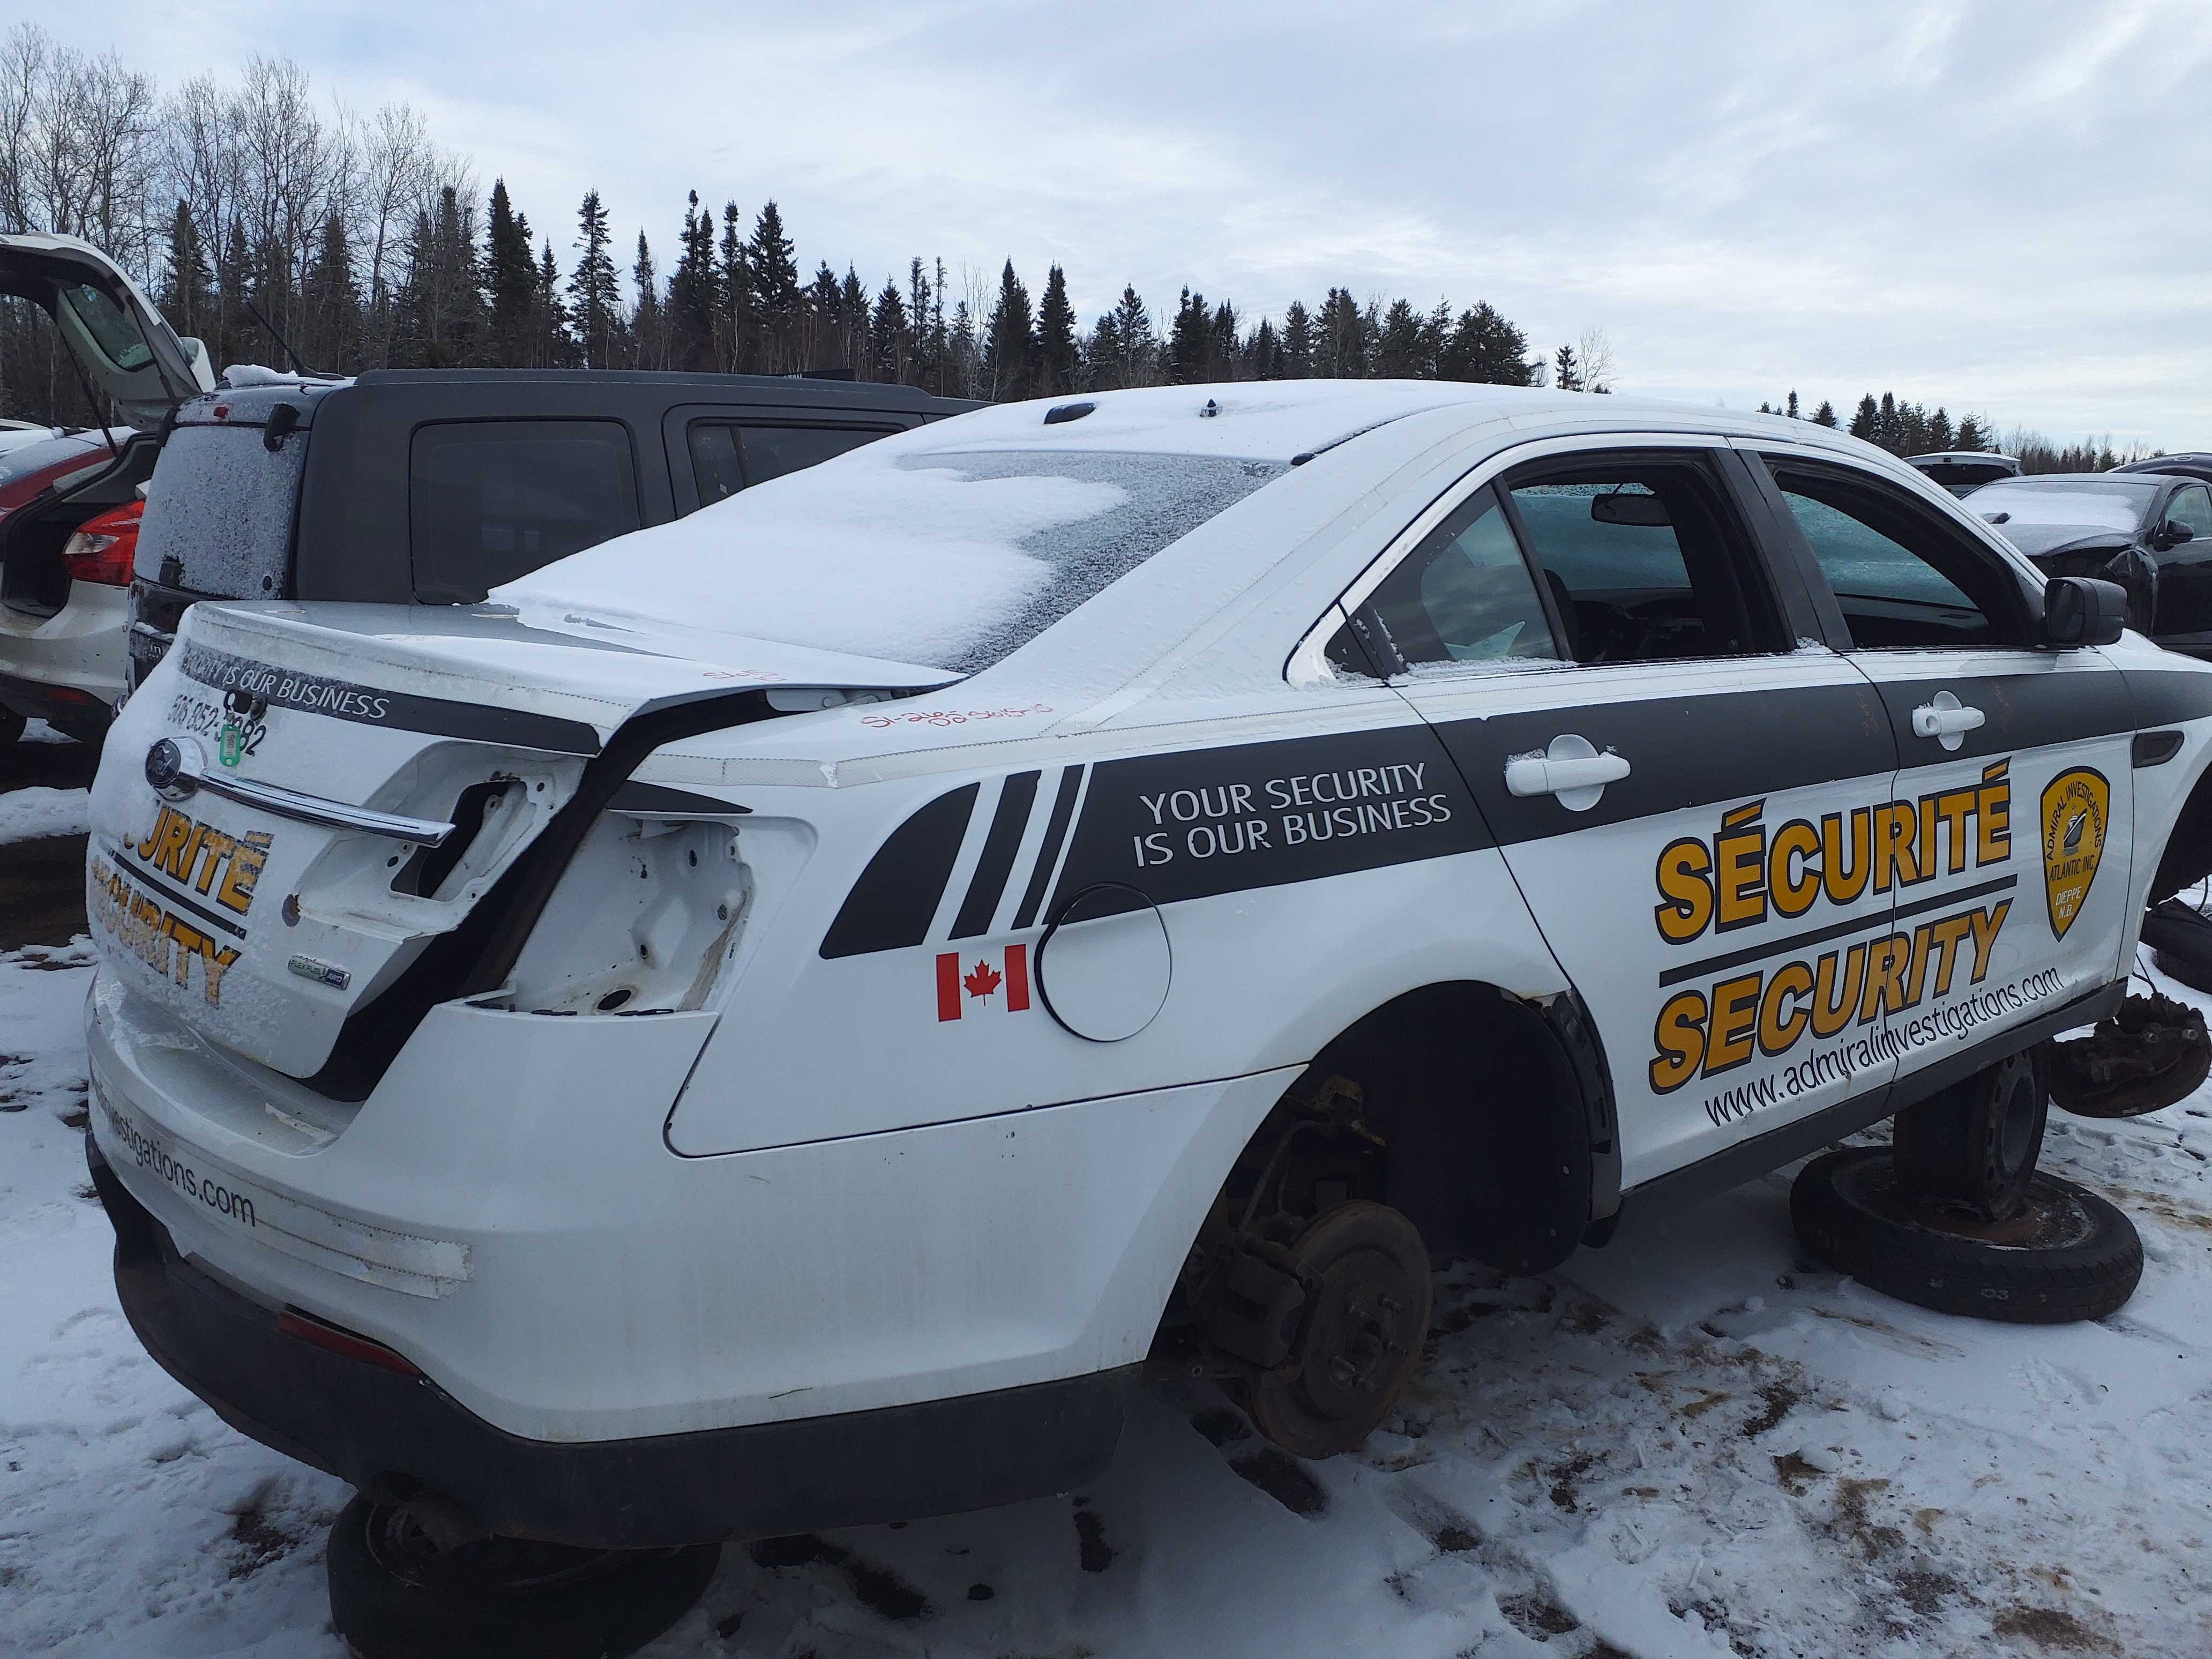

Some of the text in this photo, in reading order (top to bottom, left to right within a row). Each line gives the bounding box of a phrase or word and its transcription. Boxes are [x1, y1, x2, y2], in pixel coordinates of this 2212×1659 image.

[222, 666, 241, 685] IS
[240, 668, 276, 694] OUR
[277, 678, 390, 719] BUSINESS
[1140, 763, 1425, 825] YOUR SECURITY
[2046, 780, 2103, 861] ADMIRAL INVESTIGATIONS
[1133, 794, 1452, 867] IS OUR BUSINESS
[1654, 756, 2012, 945] SÉCURITÉ
[2049, 857, 2080, 883] ATLANTIC
[2056, 886, 2083, 906] DIEPPE
[2058, 904, 2074, 920] N.B.
[327, 972, 343, 983] AWD
[1649, 897, 2014, 1095] SECURITY
[1704, 965, 2065, 1127] www.admiralinvestigations.com
